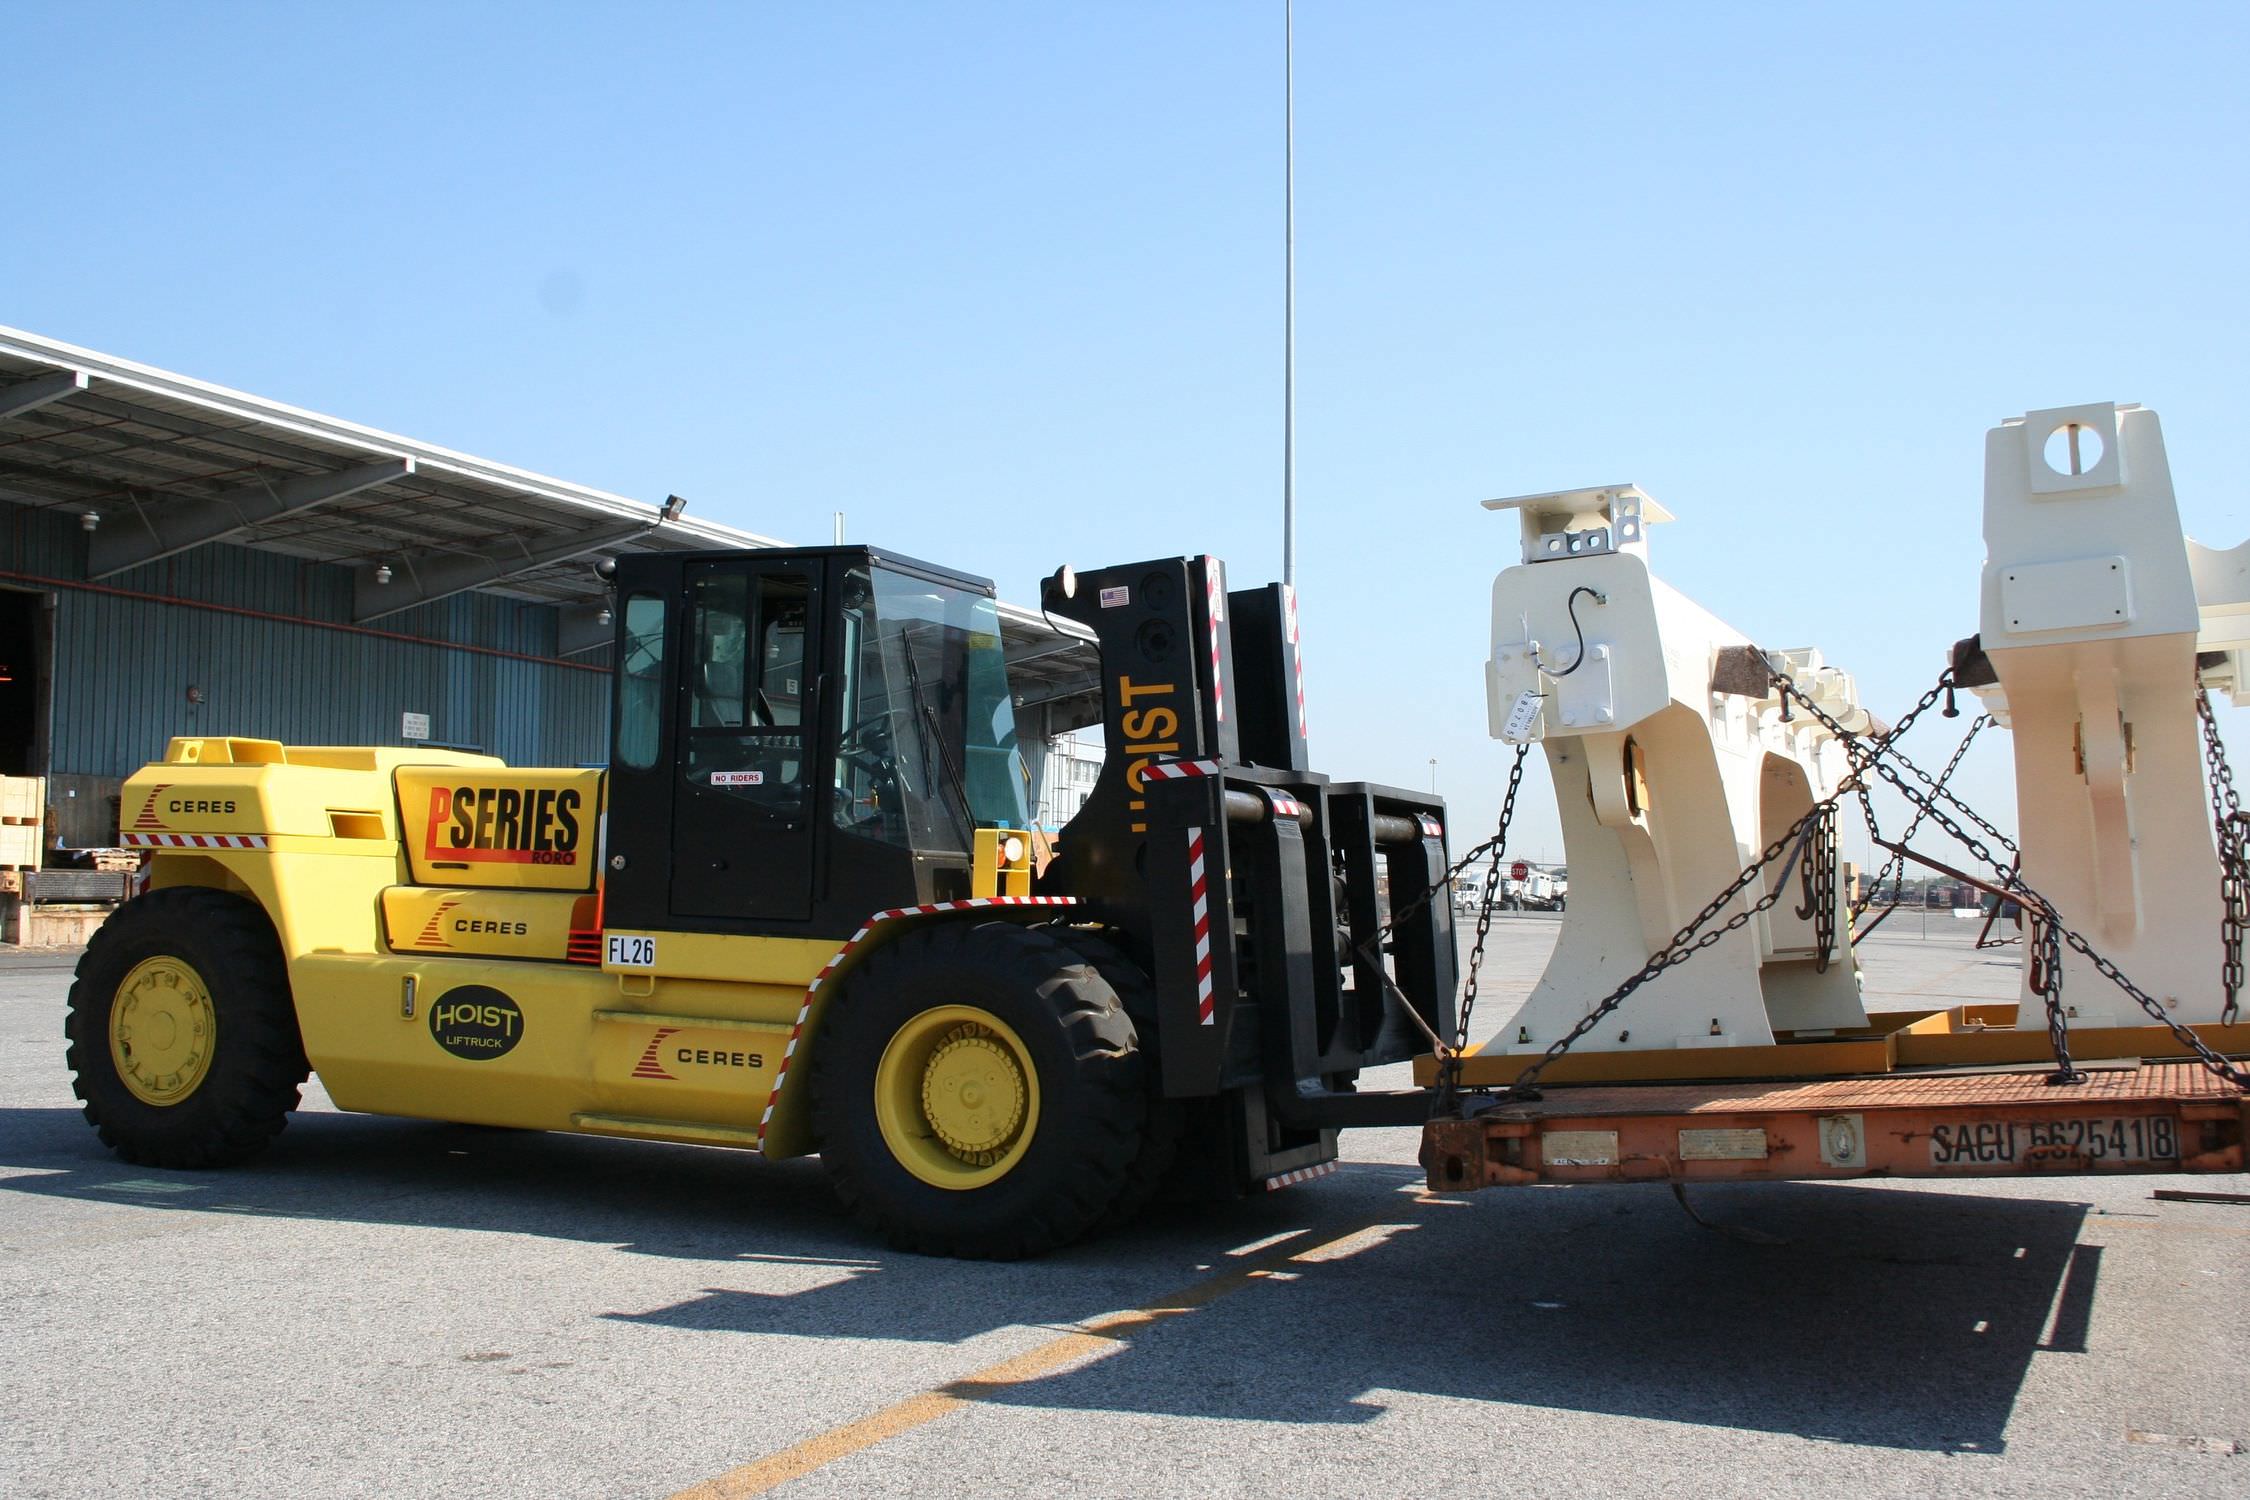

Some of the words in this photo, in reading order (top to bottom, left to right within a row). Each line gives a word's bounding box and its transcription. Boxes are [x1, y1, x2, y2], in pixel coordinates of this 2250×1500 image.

[1120, 676, 1178, 832] IST
[730, 774, 760, 782] RIDERS
[169, 800, 236, 813] CERES
[532, 851, 576, 865] RORO
[1511, 867, 1528, 876] STOP
[455, 919, 528, 935] CERES
[608, 937, 654, 965] FL26
[435, 1004, 518, 1037] HOIST
[446, 1035, 503, 1049] LIFTRUCK
[677, 1048, 763, 1068] CERES
[1933, 1121, 2015, 1163] SACU
